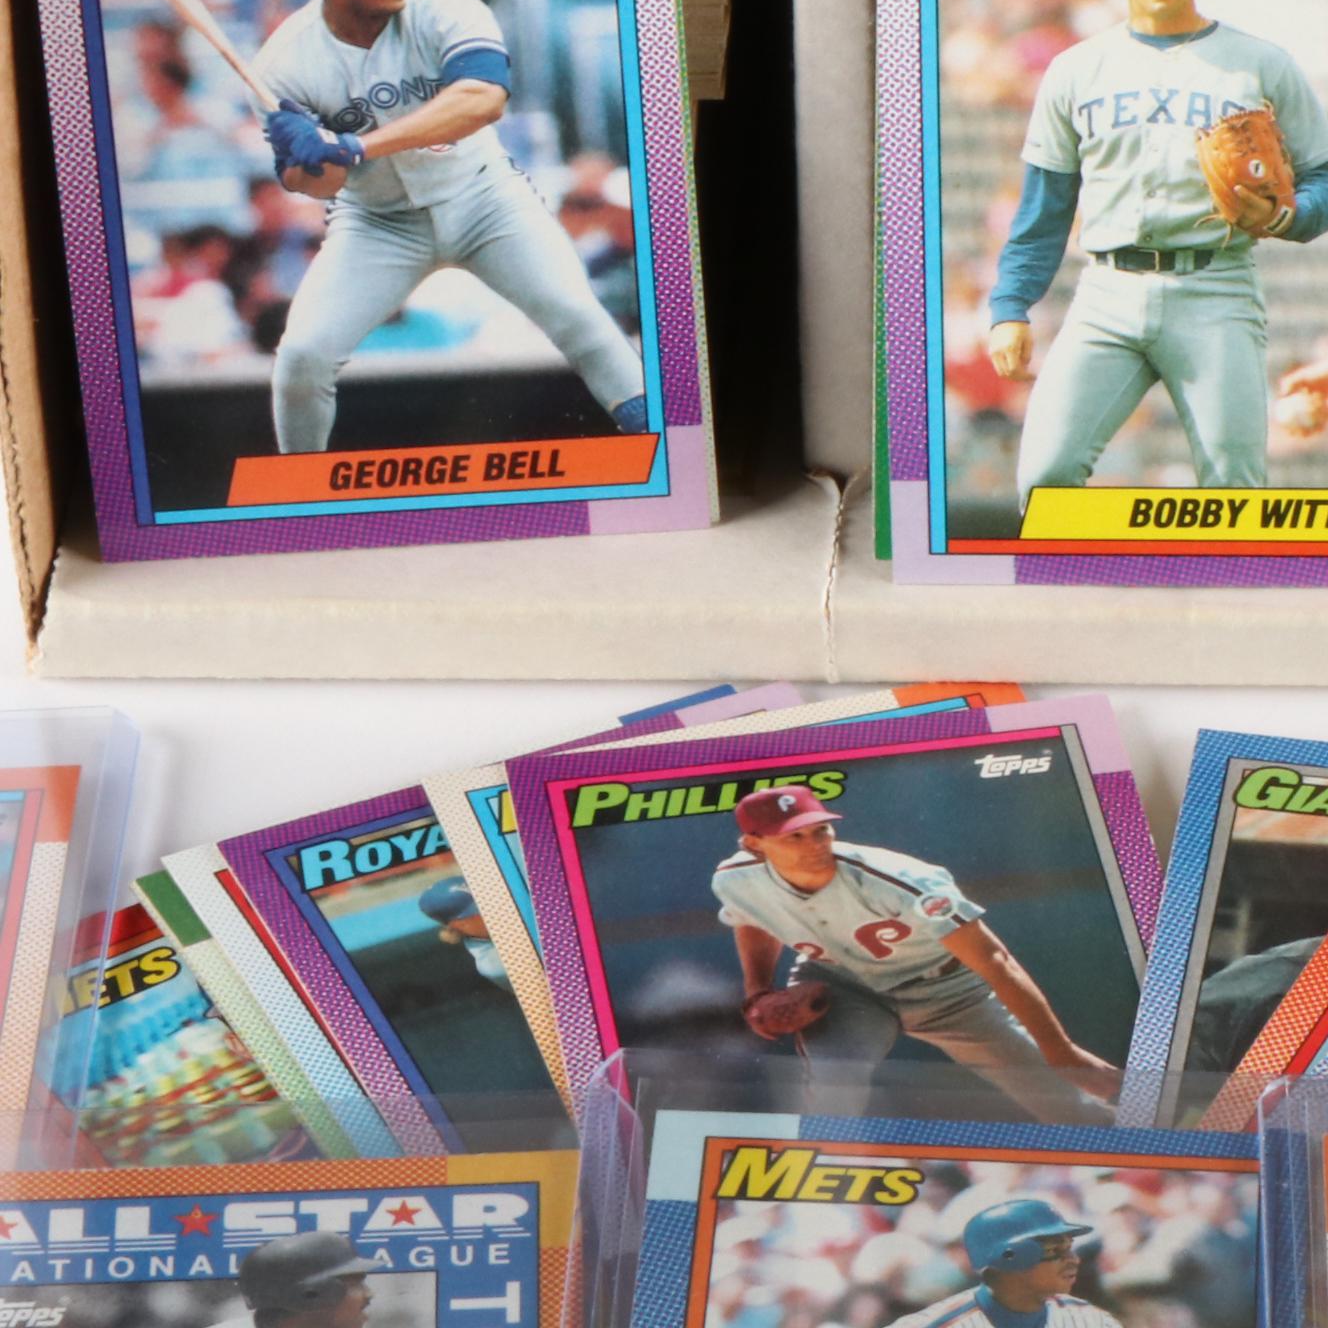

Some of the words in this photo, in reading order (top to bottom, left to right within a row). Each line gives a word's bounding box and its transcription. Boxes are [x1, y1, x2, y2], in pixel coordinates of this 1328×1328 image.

[1078, 88, 1247, 139] TEXA
[329, 454, 471, 491] GEORGE
[483, 449, 565, 481] BELL
[1129, 498, 1249, 529] BOBBY
[572, 771, 845, 827] PHILLS
[716, 1146, 923, 1204] METS
[223, 1192, 531, 1238] STAR
[10, 1254, 241, 1281] ATIONAL
